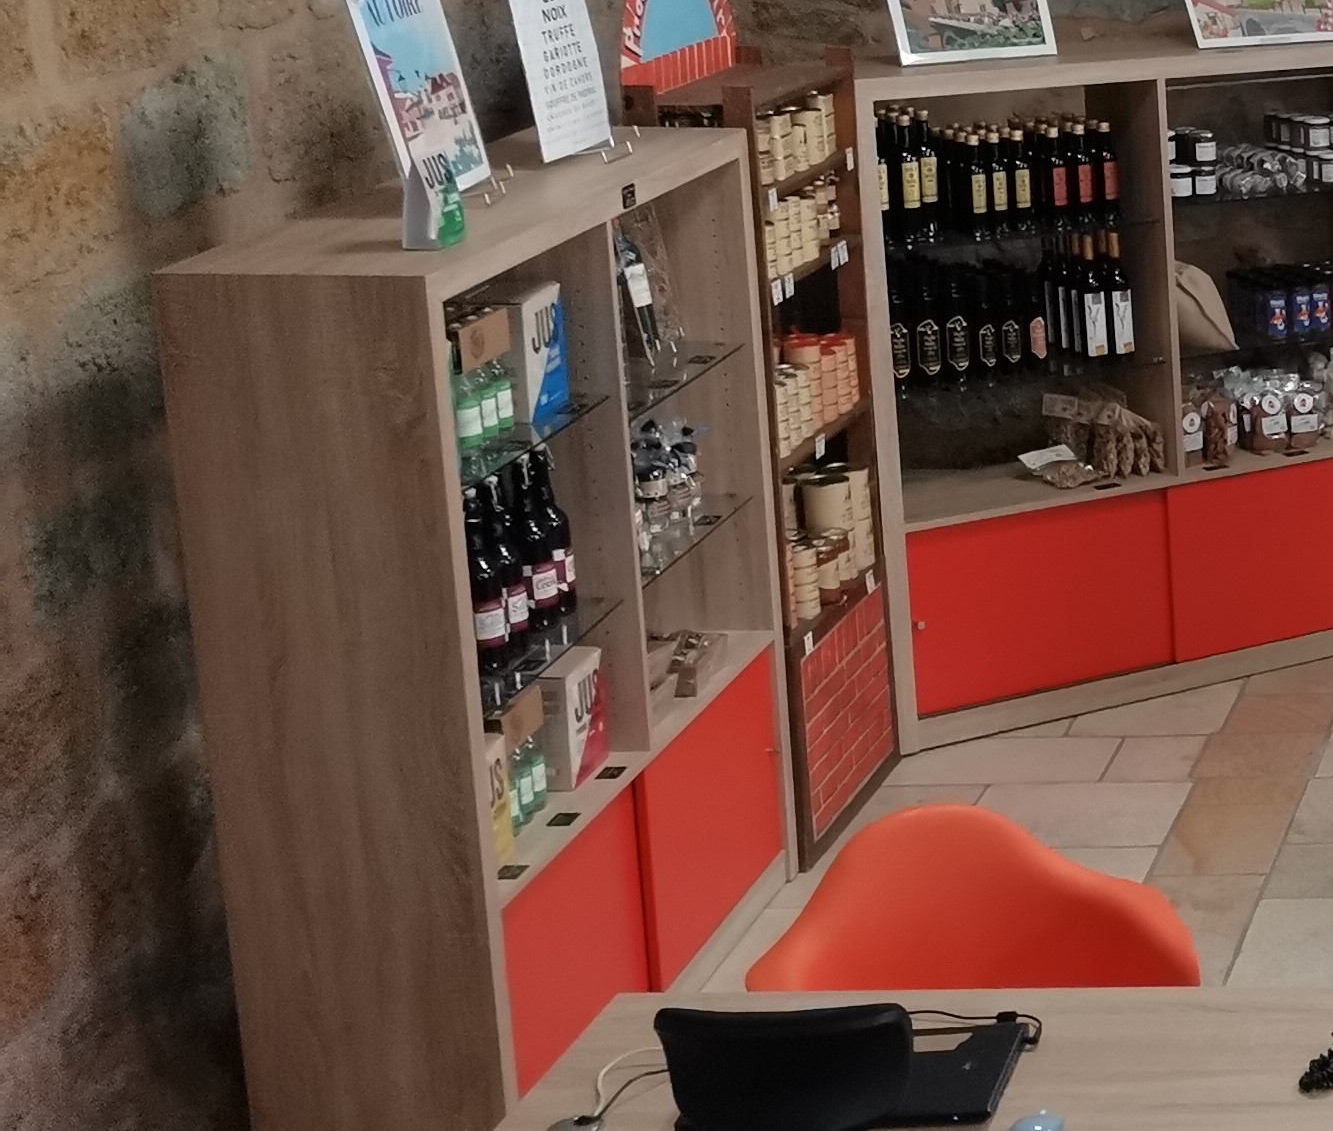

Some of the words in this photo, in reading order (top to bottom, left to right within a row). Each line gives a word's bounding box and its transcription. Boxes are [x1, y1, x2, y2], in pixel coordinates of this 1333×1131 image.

[541, 4, 569, 24] NOIX
[541, 24, 577, 46] TRUFFE
[543, 41, 583, 65] GARIOTTE
[543, 57, 589, 80] DORDOGNE
[422, 152, 455, 190] JUS
[532, 302, 560, 355] JUS
[574, 668, 601, 723] JUS
